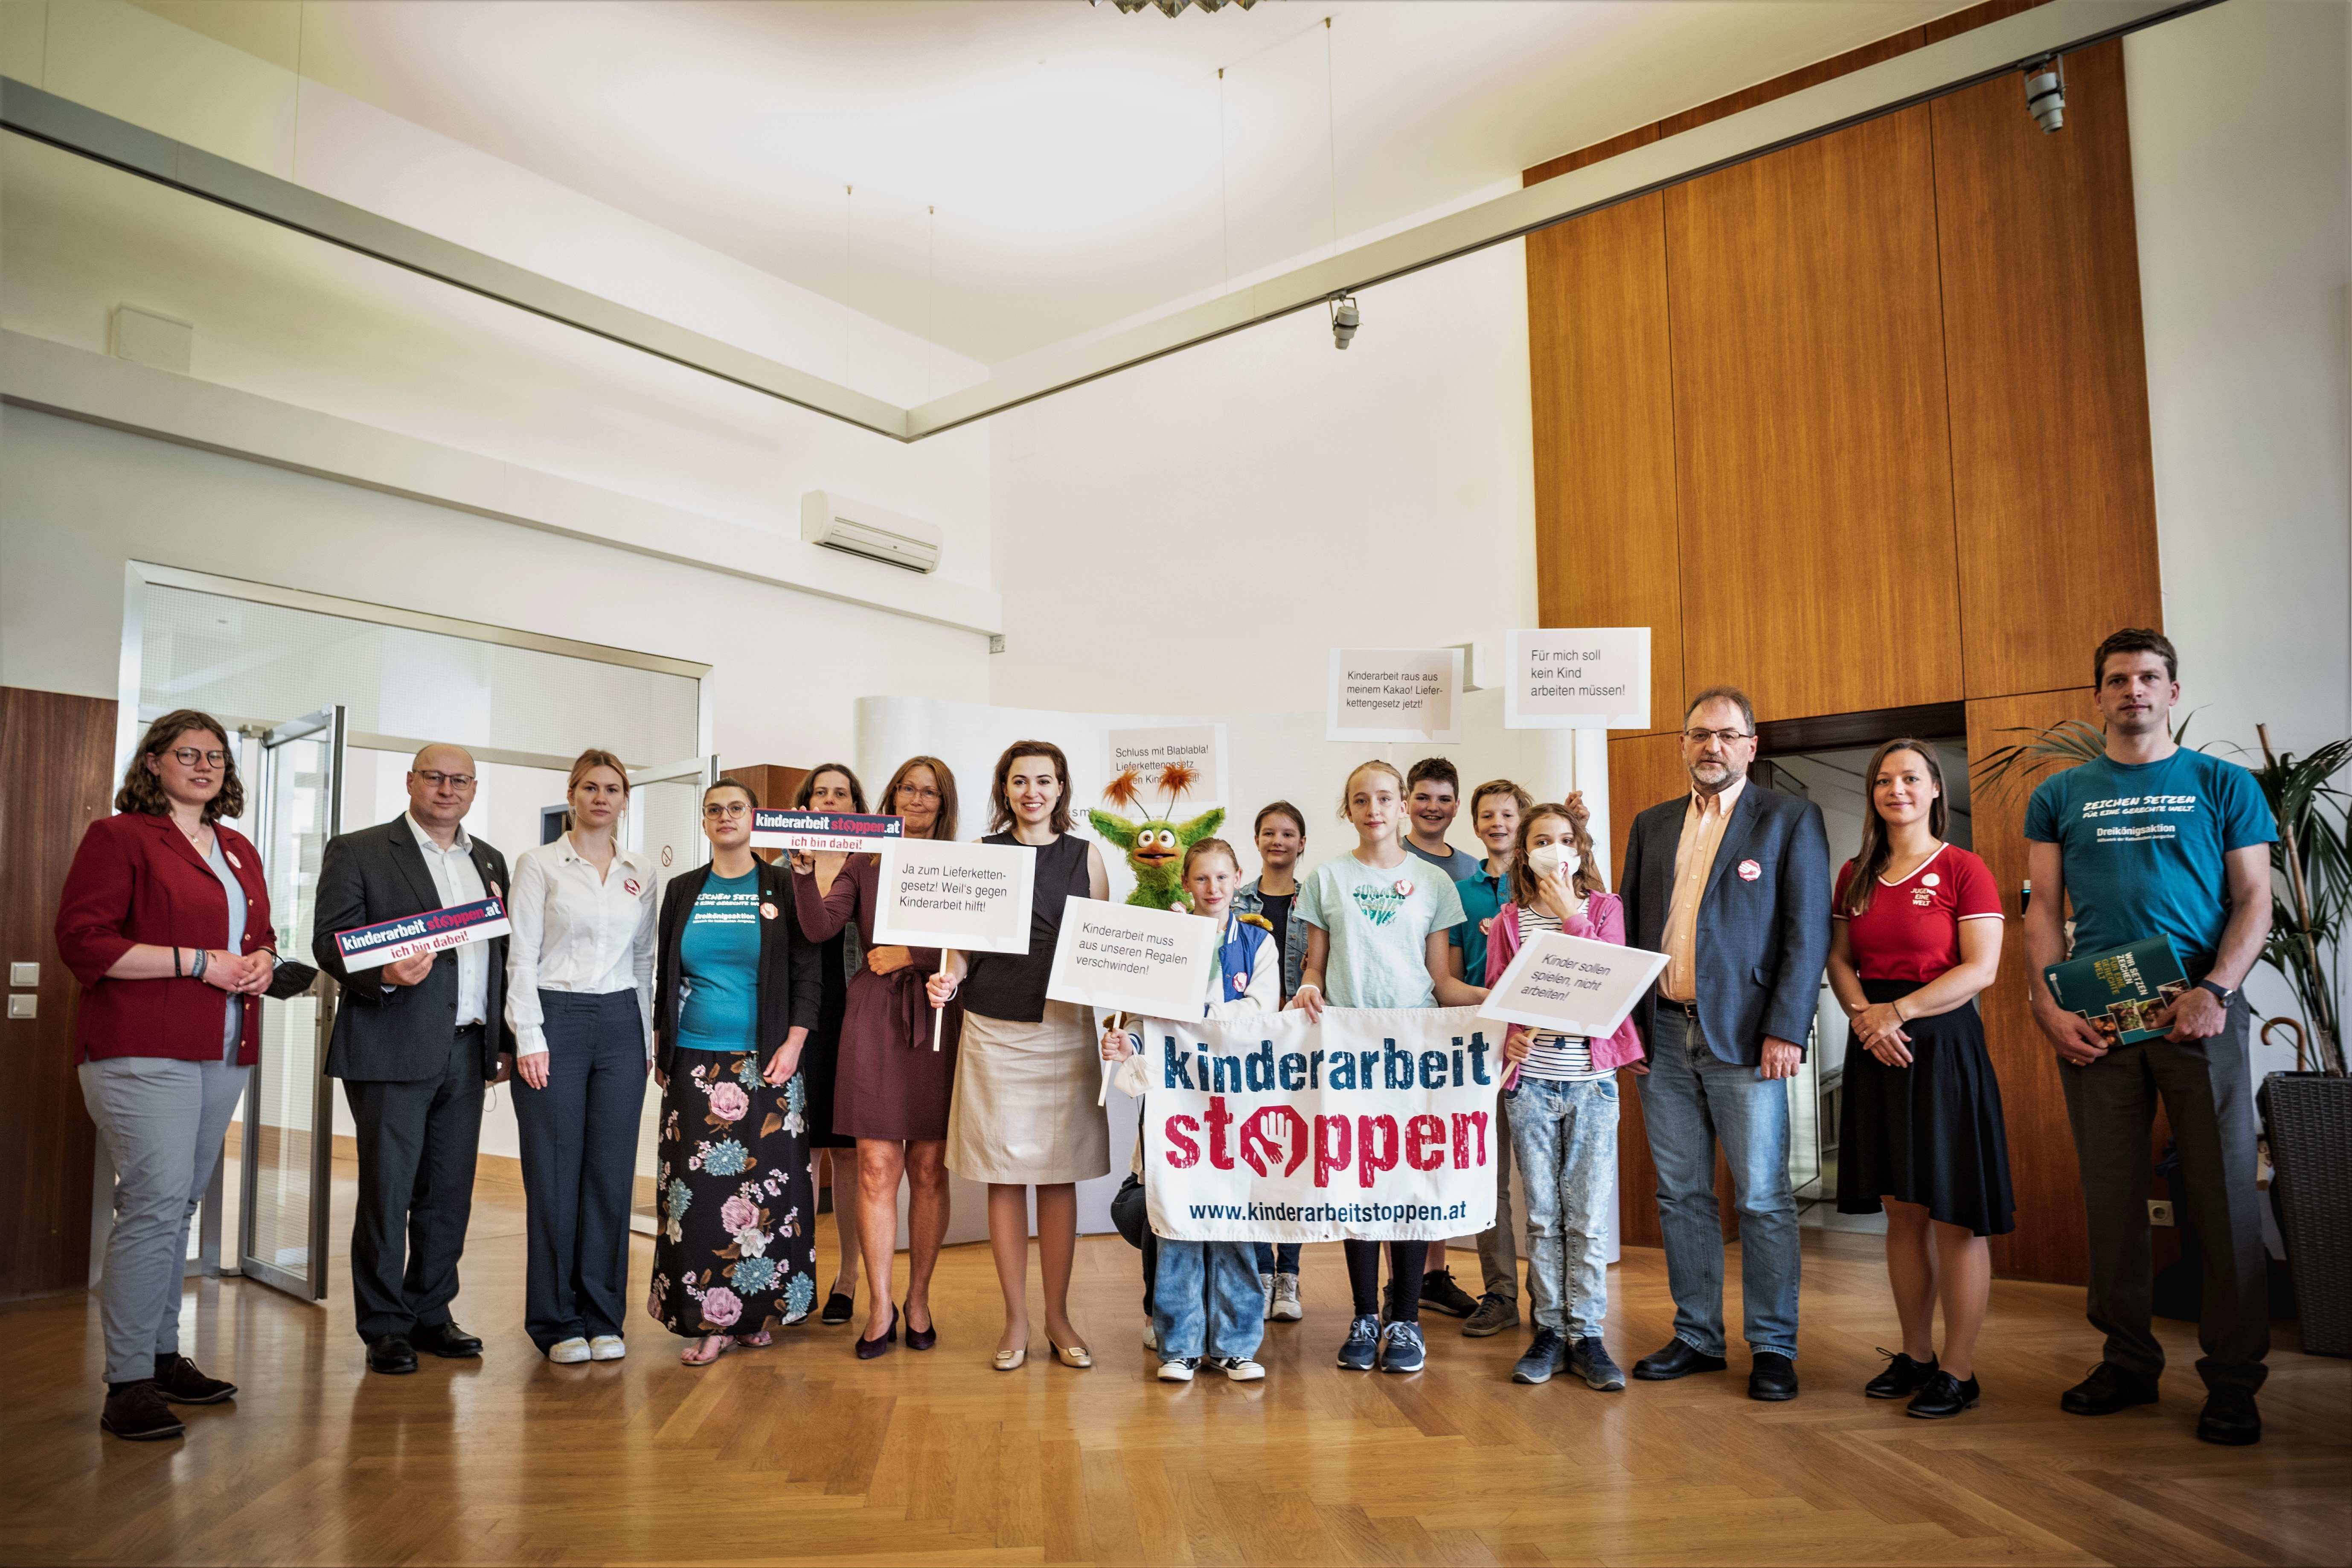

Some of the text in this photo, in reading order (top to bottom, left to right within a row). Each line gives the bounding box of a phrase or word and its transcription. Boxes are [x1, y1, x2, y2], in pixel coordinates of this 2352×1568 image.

[1531, 649, 1601, 661] Für mich soll
[1348, 671, 1399, 681] Kinderarbeit
[1531, 667, 1582, 678] kein Kind
[1347, 684, 1443, 695] meinem Kakao! Liefer-
[1531, 684, 1625, 696] arbeiten müssen!
[1346, 698, 1423, 710] kettengesetz jetzt!
[1116, 744, 1208, 758] Schluss mit Blablabla!
[2082, 795, 2196, 811] ZEICHEN SETZEN
[2122, 806, 2166, 815] GERECHTE
[756, 813, 829, 830] kinderarbeit
[2097, 824, 2175, 836] Dreikönigsaktion
[791, 836, 862, 850] ich bin dabei!
[902, 863, 1006, 880] Ja zum Lieferketten-
[901, 881, 938, 893] gesetz!
[975, 886, 1007, 898] gegen
[899, 897, 986, 913] Kinderarbeit hilft!
[342, 919, 427, 951] kinderarbeit
[1082, 922, 1174, 947] Kinderarbeit muss
[391, 931, 469, 959] ich bin dabei!
[1079, 940, 1187, 965] aus unseren Regalen
[1076, 956, 1149, 975] verschwinden!
[1541, 954, 1611, 976] Kinder sollen
[2094, 961, 2106, 980] WELT
[2116, 954, 2134, 985] ZEICHEN
[2125, 951, 2149, 996] WIR SETZEN
[1531, 970, 1602, 991] spielen, nicht
[2102, 959, 2121, 995] GERECHTE
[2114, 972, 2126, 988] EINE
[1521, 985, 1570, 1001] arbeiten!
[1164, 1032, 1491, 1093] kinderarbeit
[1189, 1201, 1466, 1224] www.kinderarbeitstoppen.at
